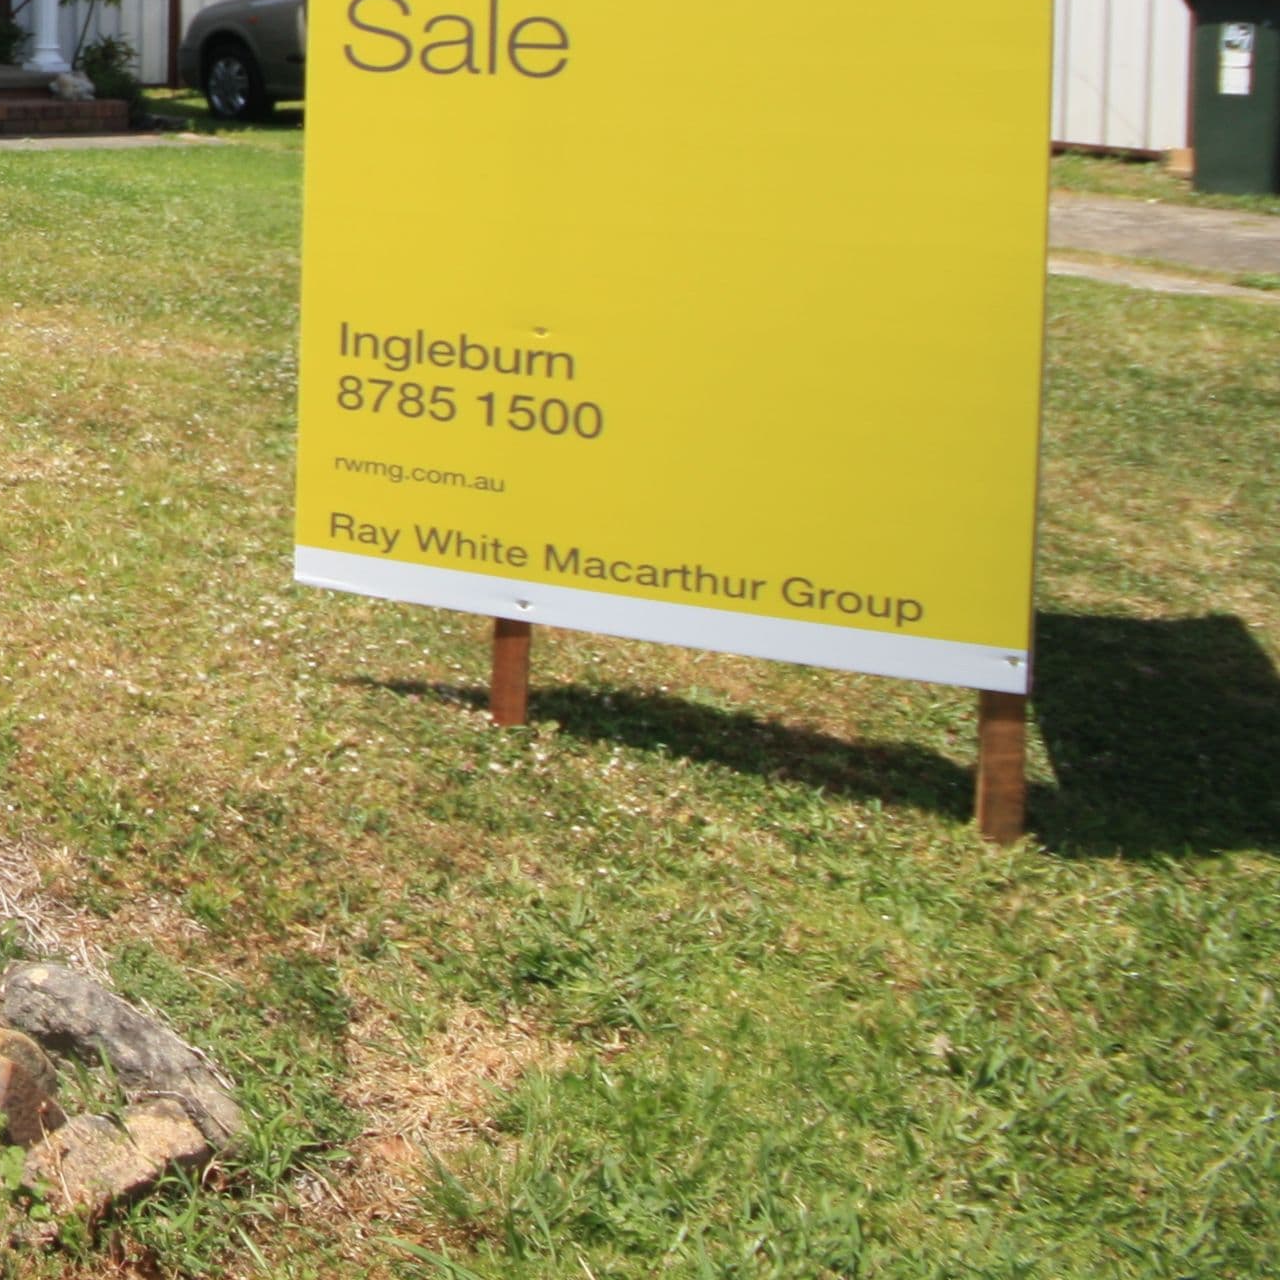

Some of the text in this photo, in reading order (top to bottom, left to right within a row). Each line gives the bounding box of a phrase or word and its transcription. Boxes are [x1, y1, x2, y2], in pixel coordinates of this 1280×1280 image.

[339, 321, 575, 381] Ingleburn
[336, 375, 604, 440] 8785 1500
[334, 455, 507, 493] rwmg.com.au
[329, 511, 925, 628] Ray White Macarthur Group
